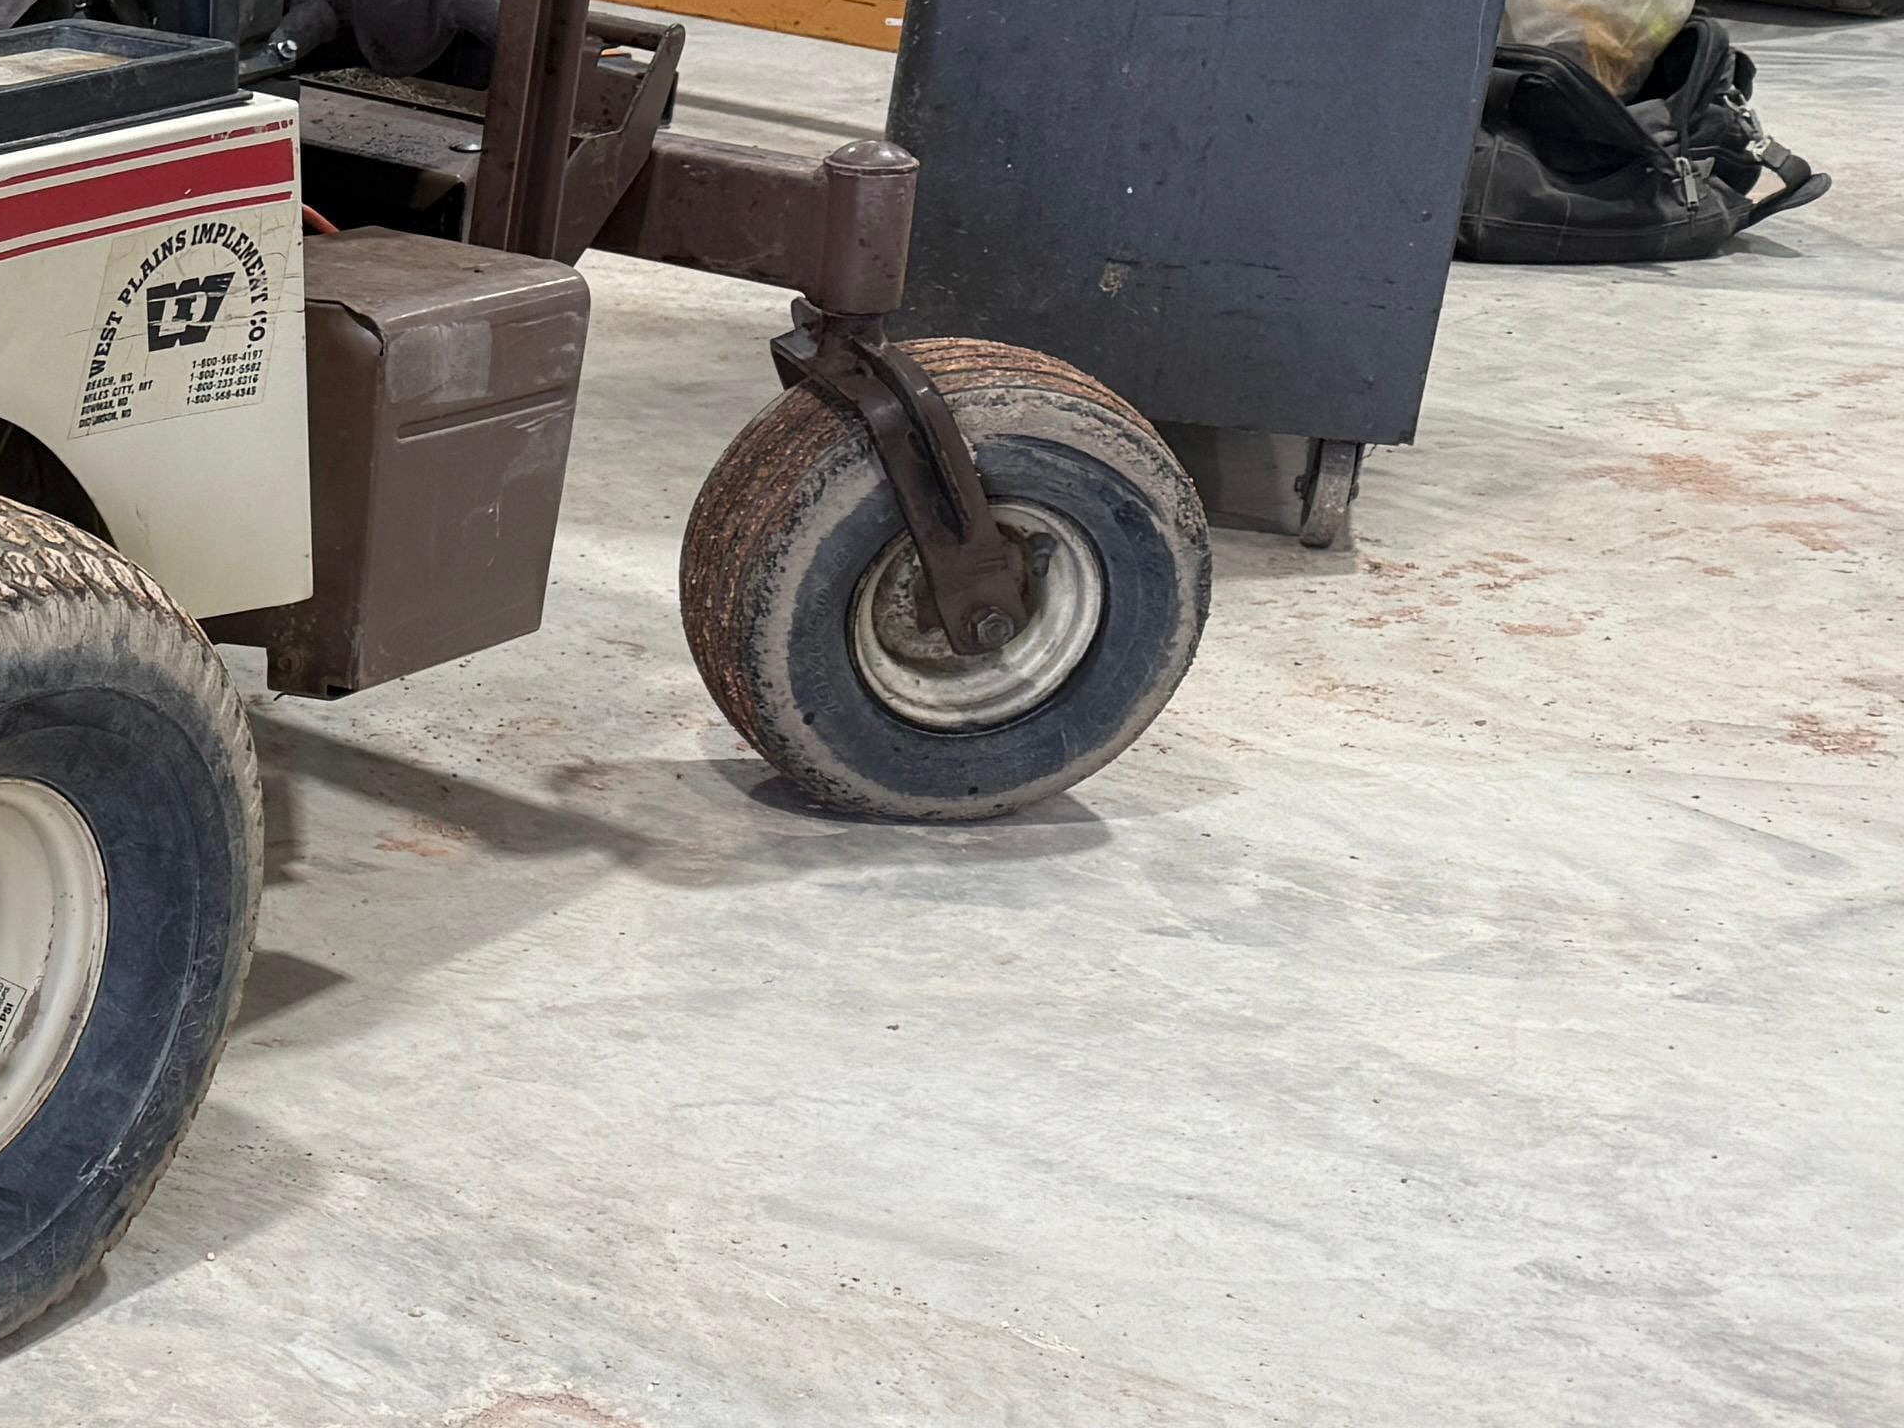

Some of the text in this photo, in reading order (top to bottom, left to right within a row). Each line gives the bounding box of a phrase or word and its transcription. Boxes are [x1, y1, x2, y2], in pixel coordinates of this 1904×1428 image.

[89, 311, 123, 379] WEST
[118, 229, 187, 307] PLAINS
[190, 222, 269, 305] IMPLEMENT
[83, 389, 110, 404] MILES
[111, 384, 135, 397] CITY,
